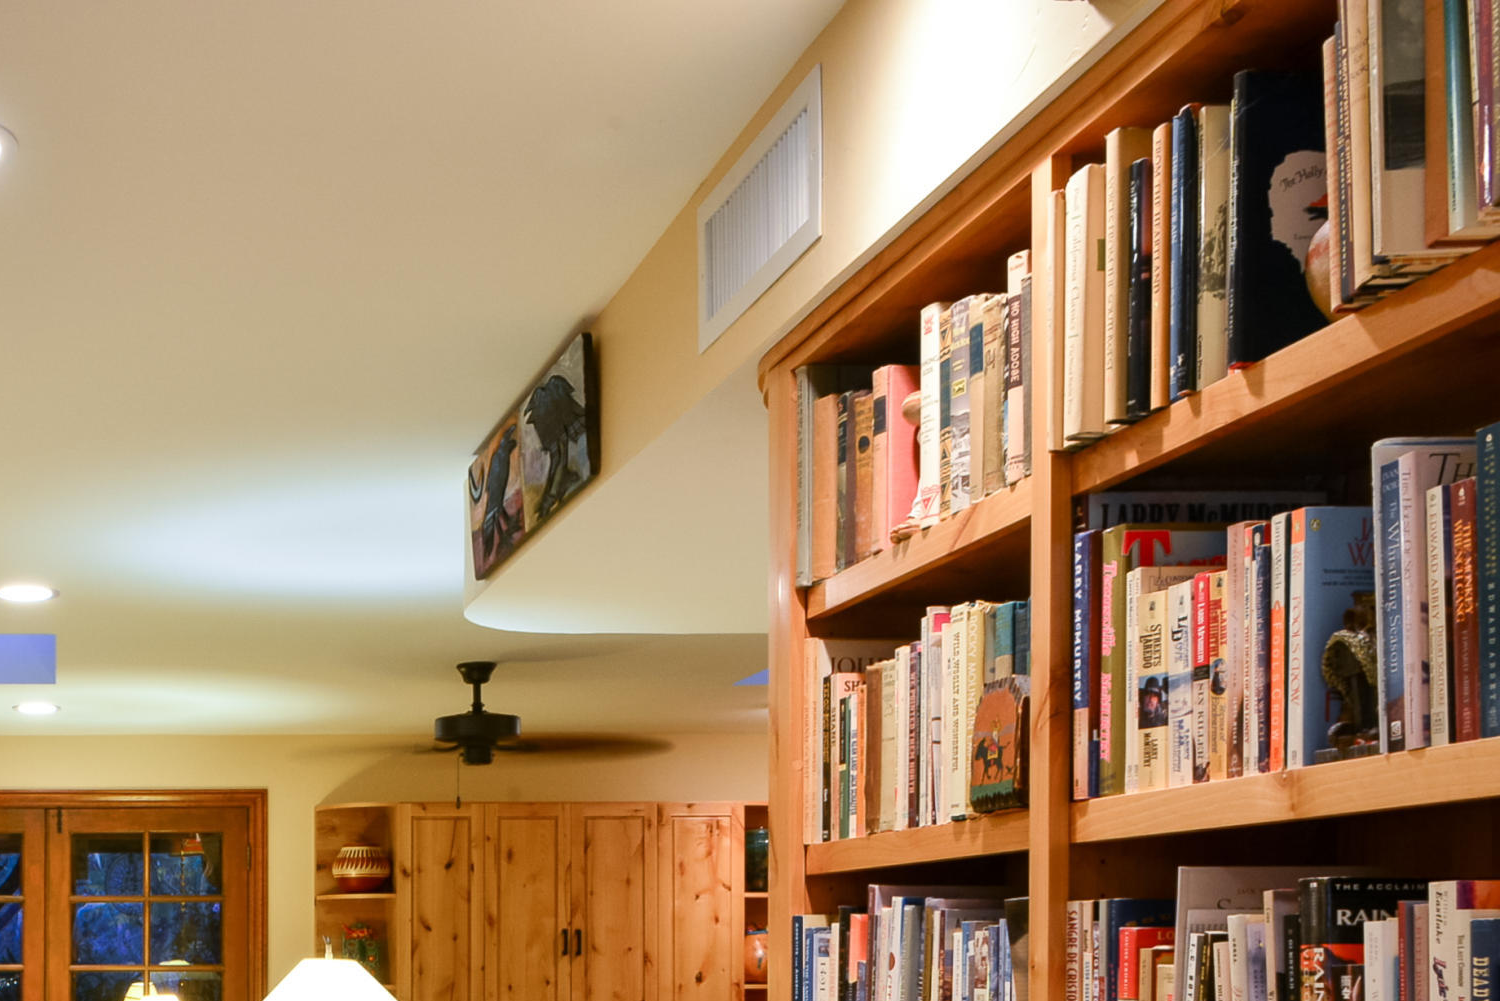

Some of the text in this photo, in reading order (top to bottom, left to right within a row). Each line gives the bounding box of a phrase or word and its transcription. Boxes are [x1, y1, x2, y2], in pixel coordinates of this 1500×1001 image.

[1153, 139, 1163, 295] FROM THE HEARTLAND
[1010, 301, 1021, 383] NO HIGH ADOBE
[1273, 520, 1283, 591] James Welch
[1429, 514, 1441, 621] EDWARD ABBEY
[1464, 521, 1474, 553] THE
[1075, 541, 1084, 702] LARRY McMURTRY
[1385, 521, 1401, 673] Whistling Season
[1454, 575, 1467, 625] GANG
[1487, 582, 1496, 644] EDWARD
[1138, 634, 1154, 670] LAREDO
[1149, 623, 1163, 668] STREETS
[966, 663, 977, 731] MOUNTAIN
[1272, 622, 1284, 742] FOOLS CROW
[1290, 659, 1302, 707] CROW
[1150, 738, 1159, 761] LARRY
[1195, 684, 1206, 762] SIN KILLER
[1335, 883, 1360, 892] THE
[1335, 908, 1399, 927] RAIN
[1066, 910, 1078, 1001] SANGRE DE CRISTO
